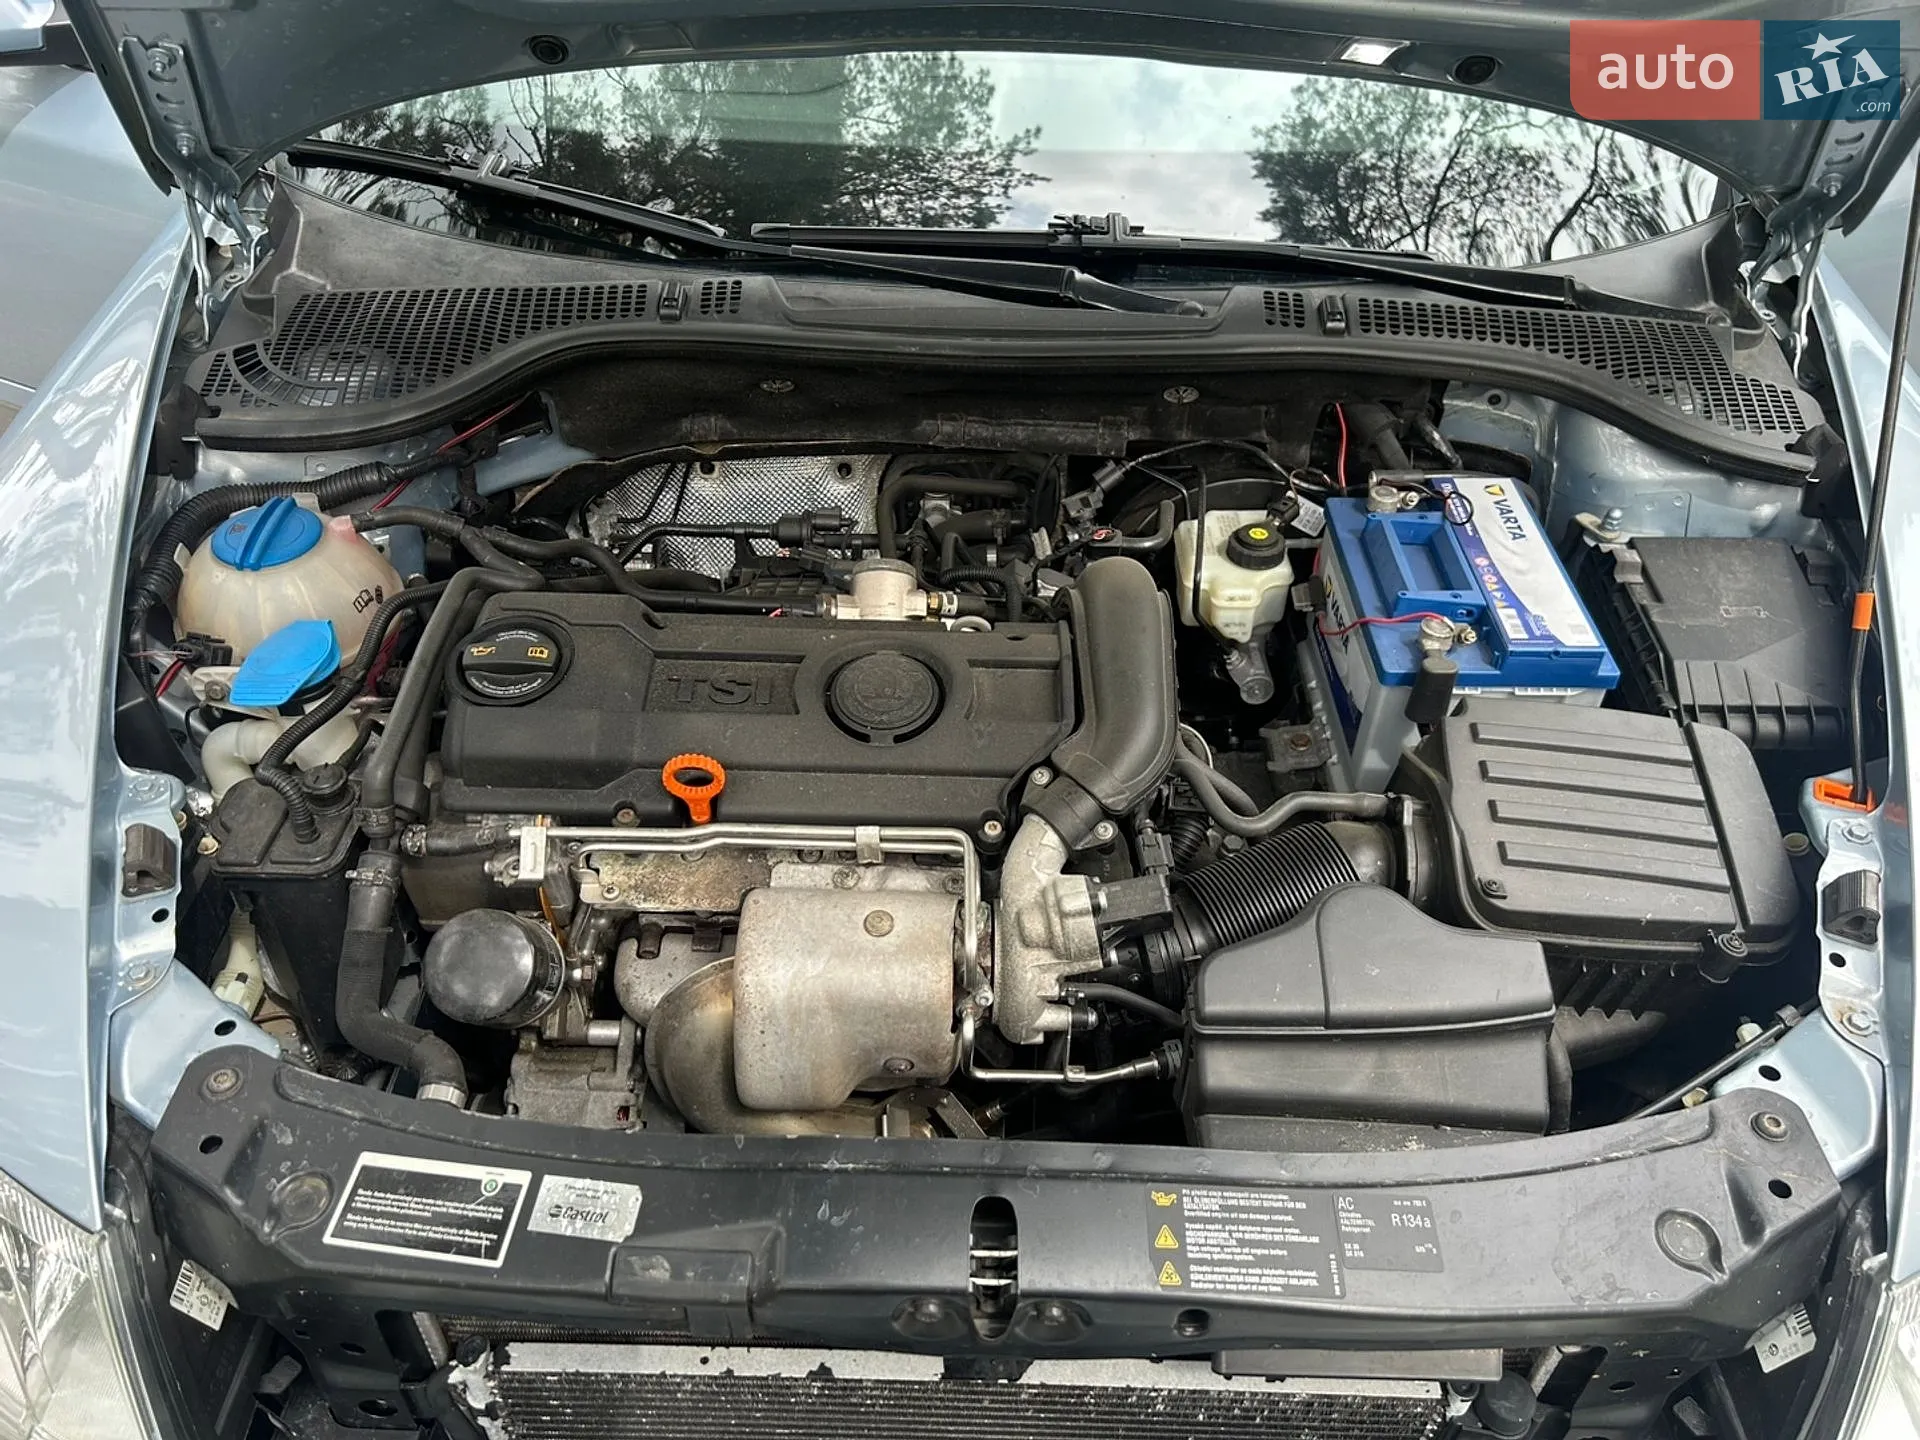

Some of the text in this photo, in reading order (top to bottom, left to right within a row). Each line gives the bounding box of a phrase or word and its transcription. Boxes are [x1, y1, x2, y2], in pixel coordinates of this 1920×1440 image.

[1493, 498, 1527, 541] VARTA
[666, 673, 773, 705] TSI
[562, 1206, 609, 1224] Castrol
[1338, 1195, 1354, 1210] AC
